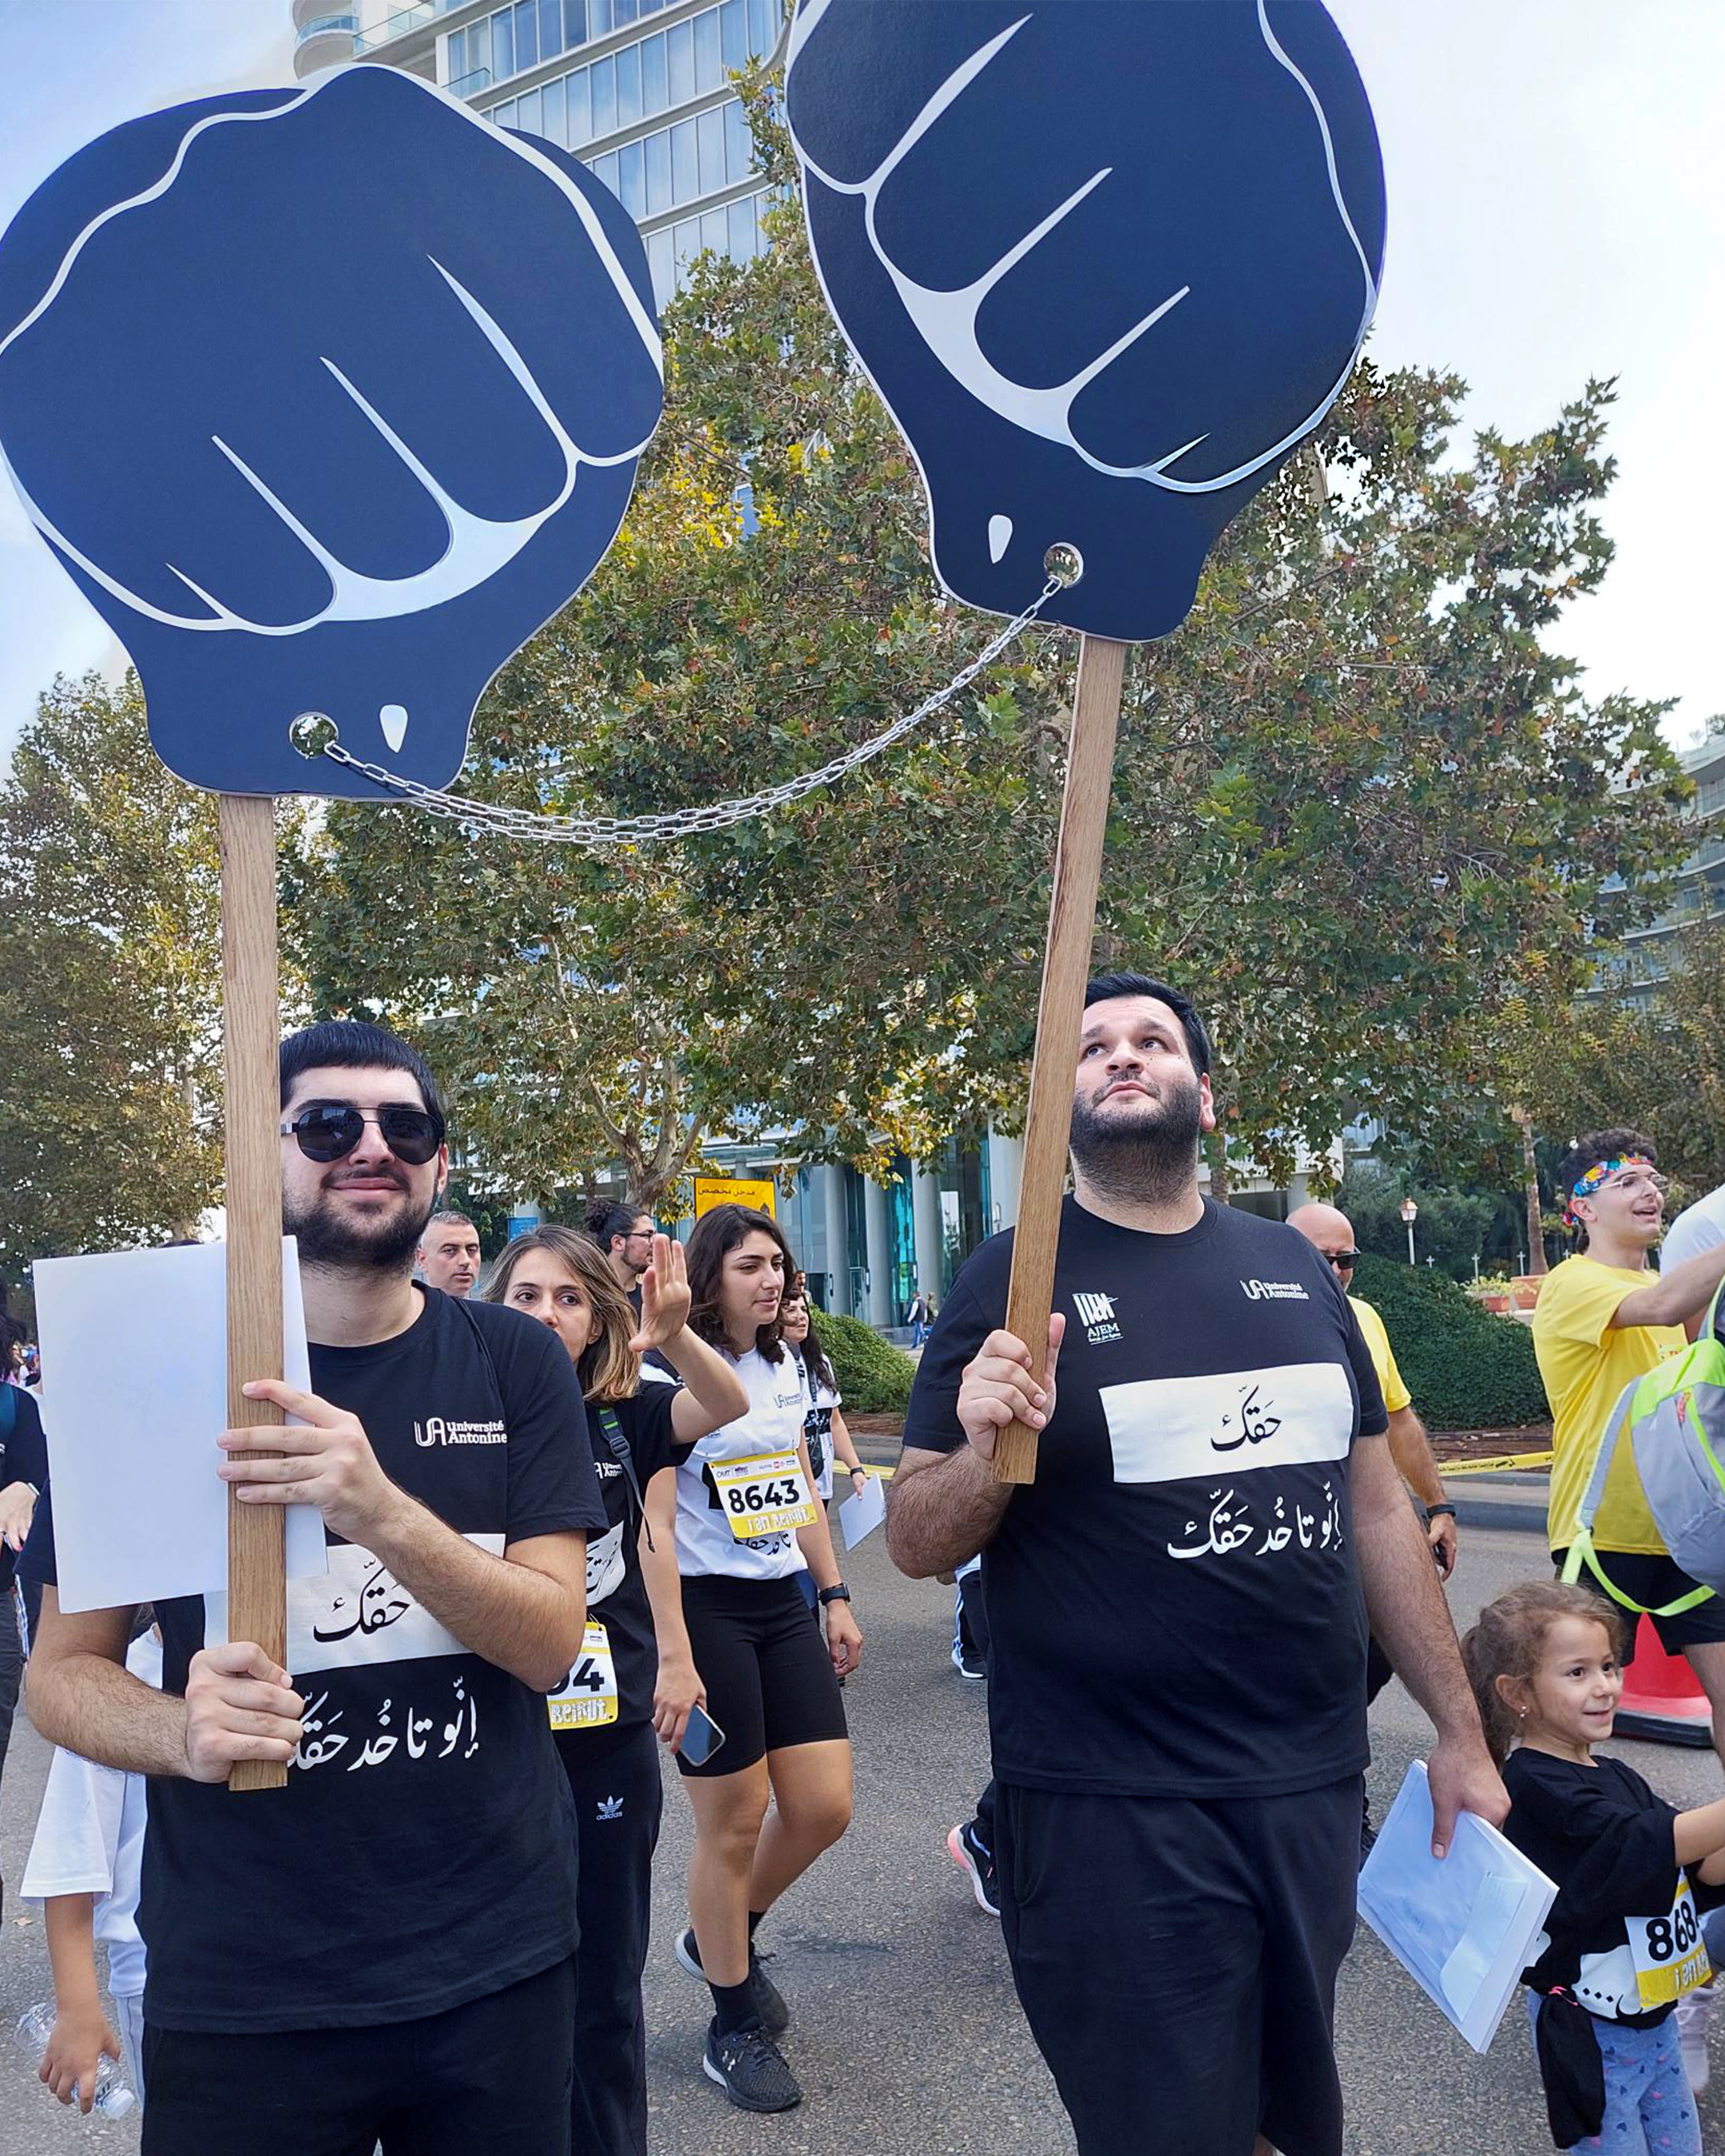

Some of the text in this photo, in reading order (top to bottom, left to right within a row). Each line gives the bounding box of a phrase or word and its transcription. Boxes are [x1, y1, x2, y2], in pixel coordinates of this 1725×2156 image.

[1269, 1289, 1310, 1300] Antonine
[1087, 1322, 1120, 1338] AJEM
[447, 1432, 508, 1445] Antonine
[728, 1479, 800, 1514] 8643
[596, 1811, 623, 1821] adidas
[1646, 1900, 1699, 1961] 868
